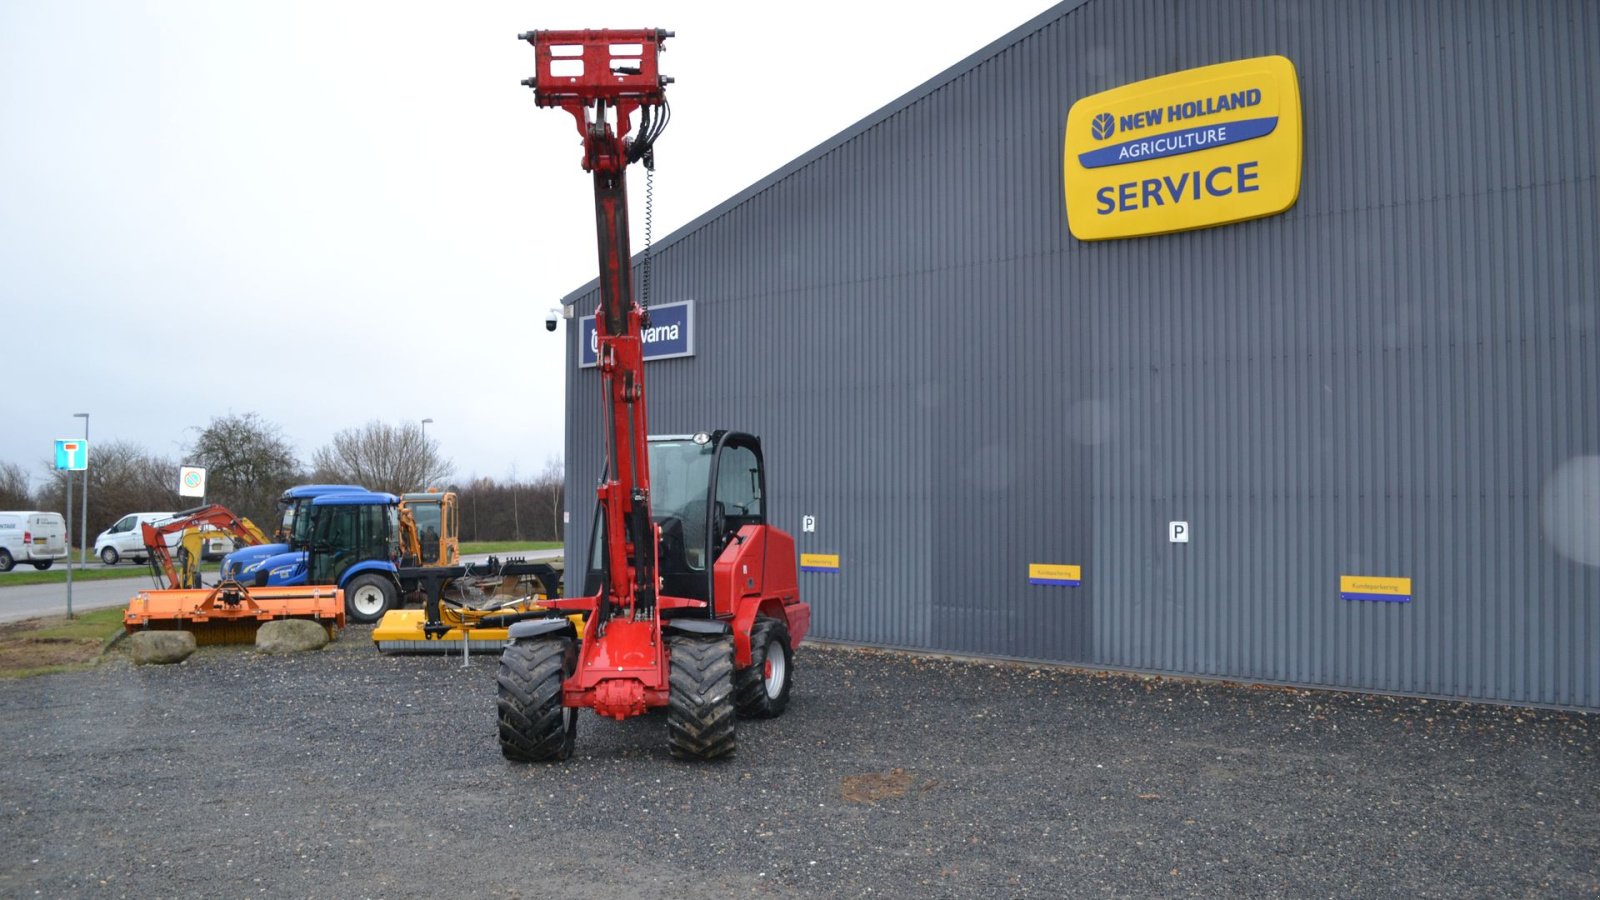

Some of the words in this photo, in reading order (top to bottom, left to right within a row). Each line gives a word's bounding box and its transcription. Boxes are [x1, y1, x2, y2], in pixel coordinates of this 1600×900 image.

[1120, 106, 1164, 132] NEW
[1167, 88, 1261, 123] HOLLAND
[1119, 127, 1226, 160] AGRICULTURE
[1096, 161, 1259, 215] SERVICE
[641, 324, 679, 344] varna
[806, 518, 813, 529] P
[1174, 525, 1184, 539] P
